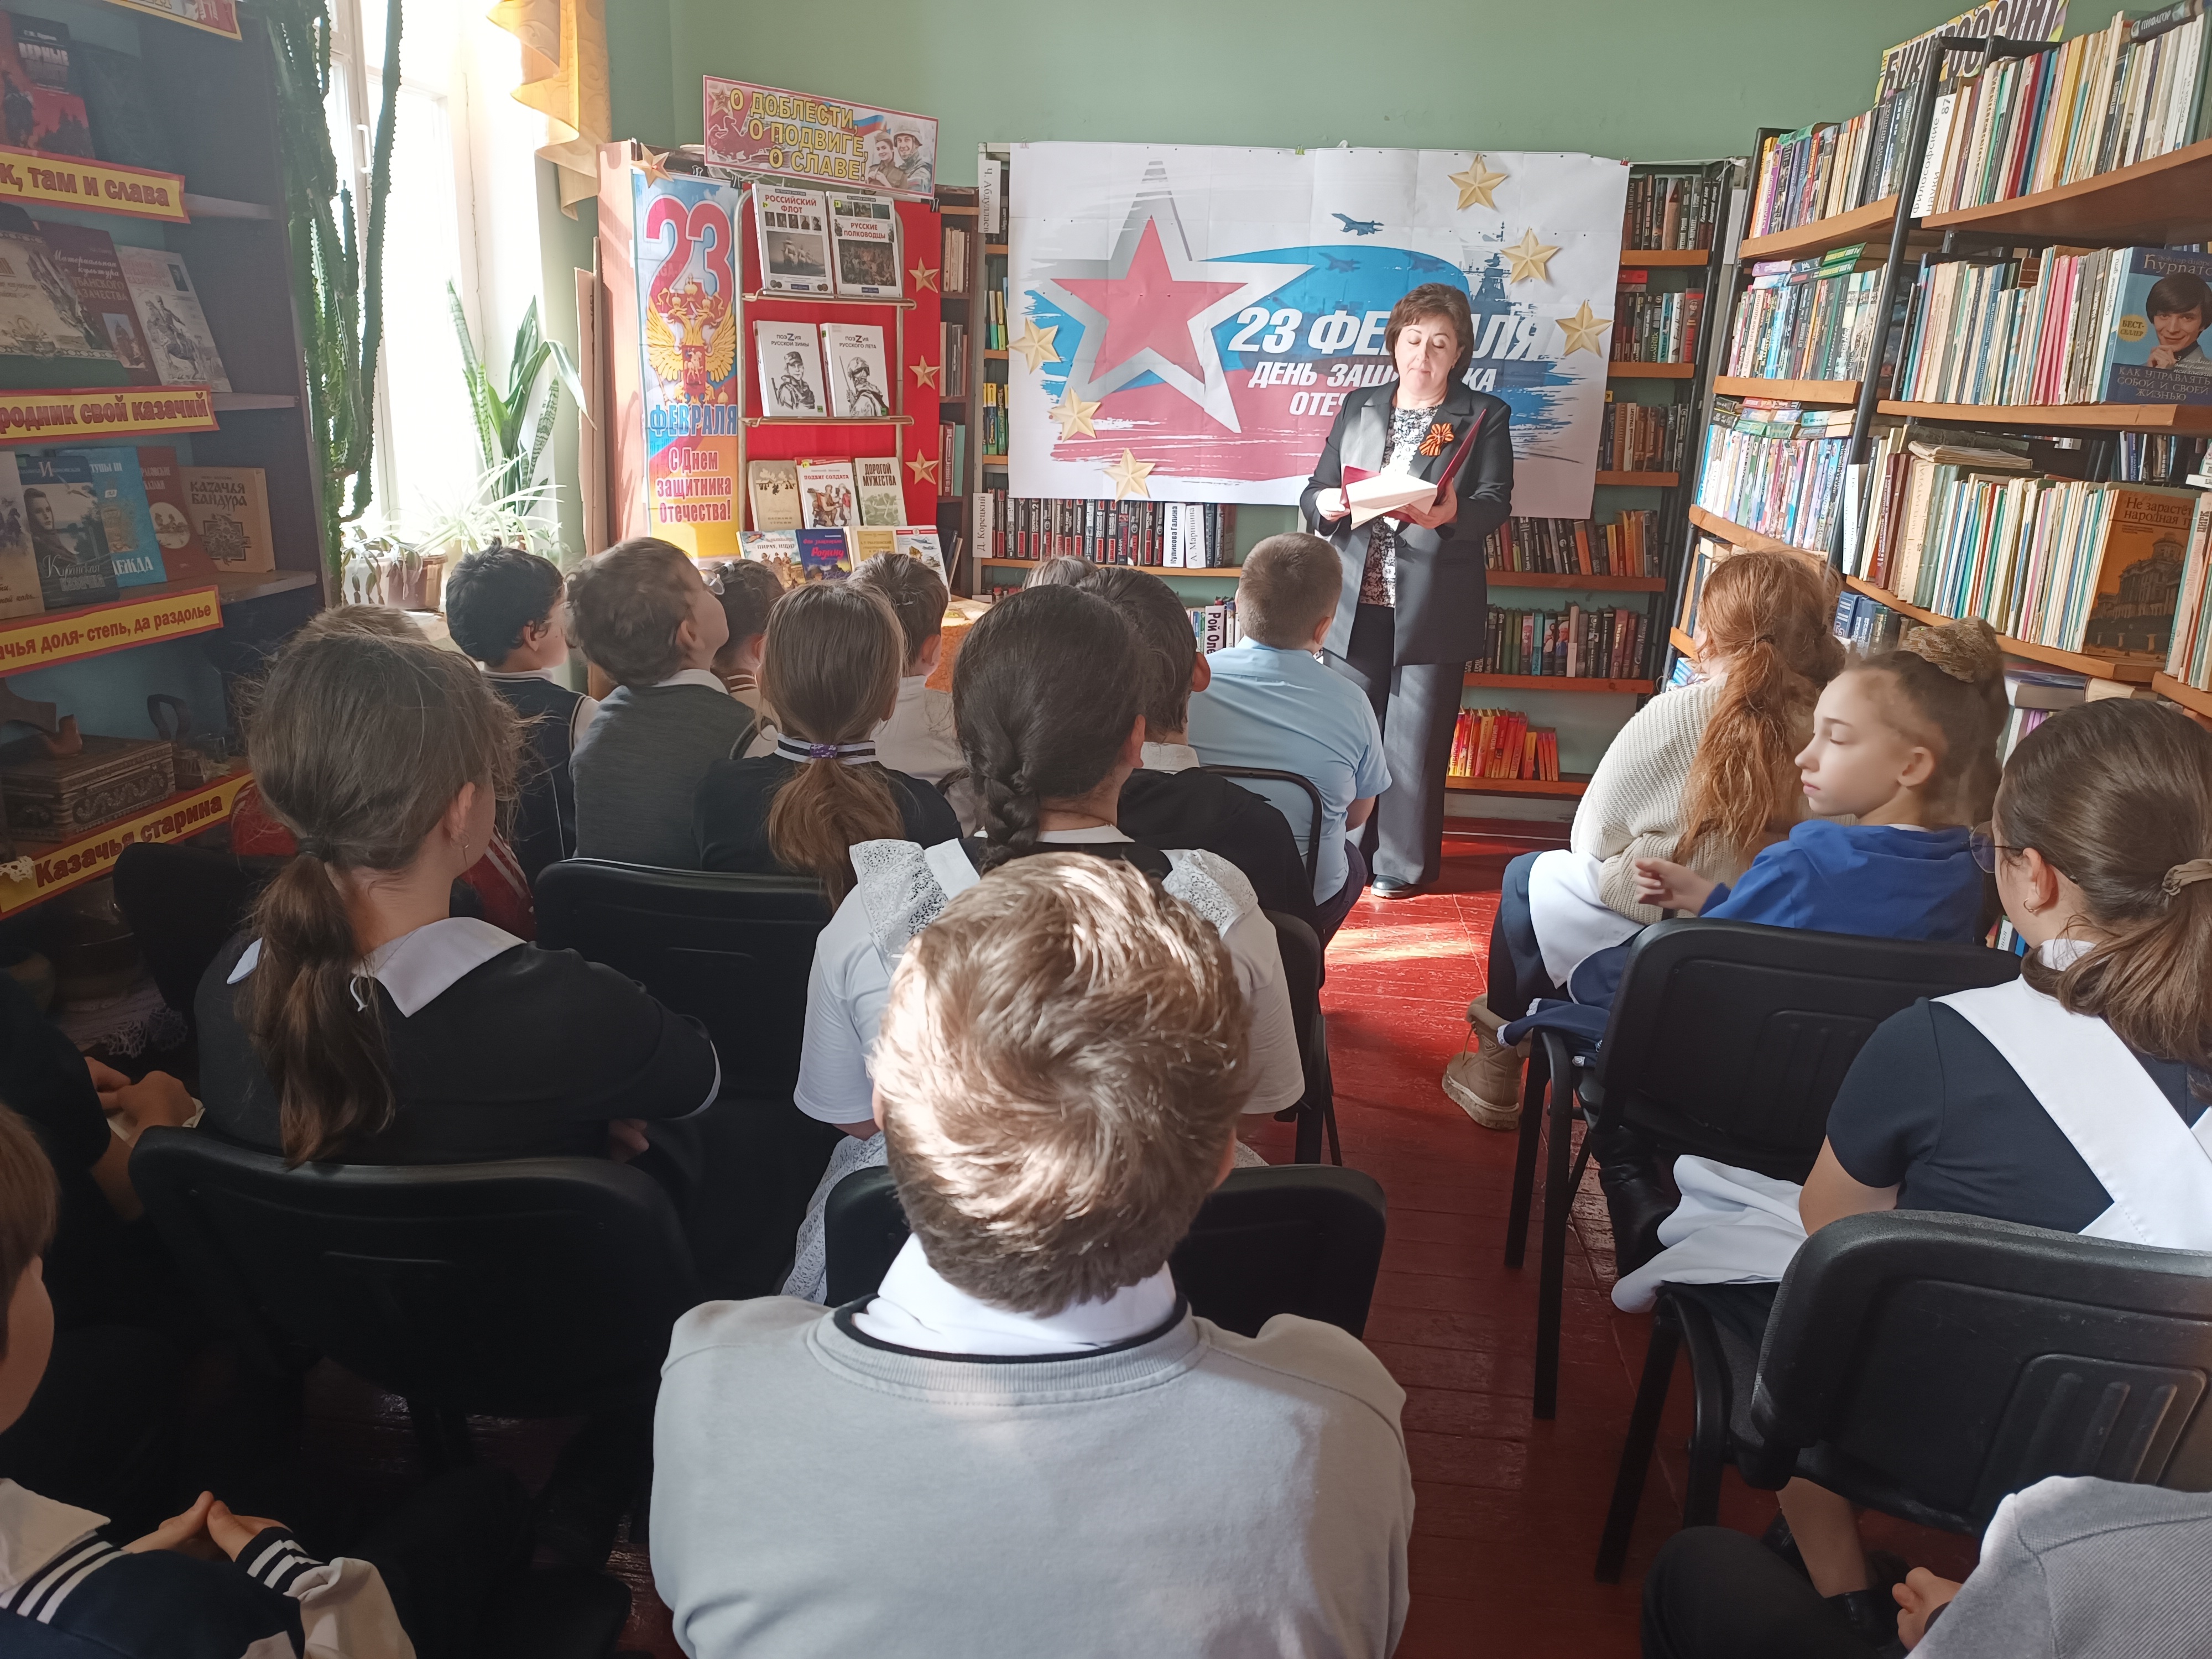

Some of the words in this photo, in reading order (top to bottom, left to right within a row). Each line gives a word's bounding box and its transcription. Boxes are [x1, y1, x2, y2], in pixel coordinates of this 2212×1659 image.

[2141, 10, 2171, 30] ПИФАГОР
[729, 88, 744, 111] О
[749, 91, 858, 135] ДОБЛЕСТИ,
[749, 118, 764, 141] О
[770, 122, 868, 160] ПОДВИГЕ,
[769, 147, 784, 169] О
[791, 152, 867, 181] СЛАВЕ!
[1913, 118, 1939, 213] Философские
[1941, 98, 1950, 114] 87
[984, 168, 993, 178] Ч.
[28, 166, 77, 194] там
[83, 175, 99, 197] и
[105, 179, 170, 207] слава
[1927, 171, 1940, 213] Науки
[765, 195, 817, 206] РОССИЙСКИЙ
[781, 205, 802, 213] ФЛОТ
[982, 180, 992, 233] Абдуллаев
[843, 230, 886, 239] ПОЛКОВОДЦЫ
[851, 222, 878, 231] РУССКИЕ
[645, 194, 733, 314] 23
[69, 276, 124, 291] УБАНСКОГО
[76, 289, 129, 301] АЗАЧЕСТВА
[2105, 276, 2116, 316] Одаренные
[1227, 307, 1303, 354] 23
[1307, 310, 1542, 361] ФЕЛЯ
[2122, 320, 2145, 328] БЕСТ-
[1248, 361, 1317, 388] ДЕНЬ
[1327, 363, 1498, 392] ЗАЩКА
[2117, 376, 2154, 388] СОБОЙ
[2172, 382, 2209, 395] СВОЕЙ
[2119, 367, 2140, 377] КАК
[2145, 369, 2211, 385] УПРАВЛЯТЬ
[2135, 388, 2187, 401] ЖИЗНЬЮ
[0, 404, 77, 435] родник
[80, 395, 128, 424] свой
[132, 392, 208, 421] казачий
[649, 404, 738, 436] ФЕВРАЛЯ
[669, 448, 679, 471] С
[682, 448, 718, 474] Днем
[864, 462, 891, 475] ДОРОГОЙ
[190, 481, 246, 495] КАЗАЧЬЯ
[657, 477, 732, 500] защитника
[863, 475, 896, 486] МУЖЕСТВА
[192, 494, 247, 511] БАНДУРА
[659, 499, 731, 523] Отечества!
[2126, 497, 2143, 509] Не
[978, 495, 987, 540] Корецкий
[2124, 510, 2179, 524] народная
[2197, 510, 2210, 533] ЦИРК
[1190, 507, 1198, 550] Маринина
[811, 546, 845, 559] Родину
[977, 541, 985, 552] Д.
[1190, 552, 1198, 562] А.
[41, 633, 84, 654] доля-
[86, 622, 131, 641] степь,
[134, 618, 151, 635] да
[154, 603, 212, 629] раздолье
[1208, 612, 1221, 632] Рой
[1207, 634, 1220, 654] Оле
[36, 831, 135, 888] Казачья
[140, 795, 223, 842] старина
